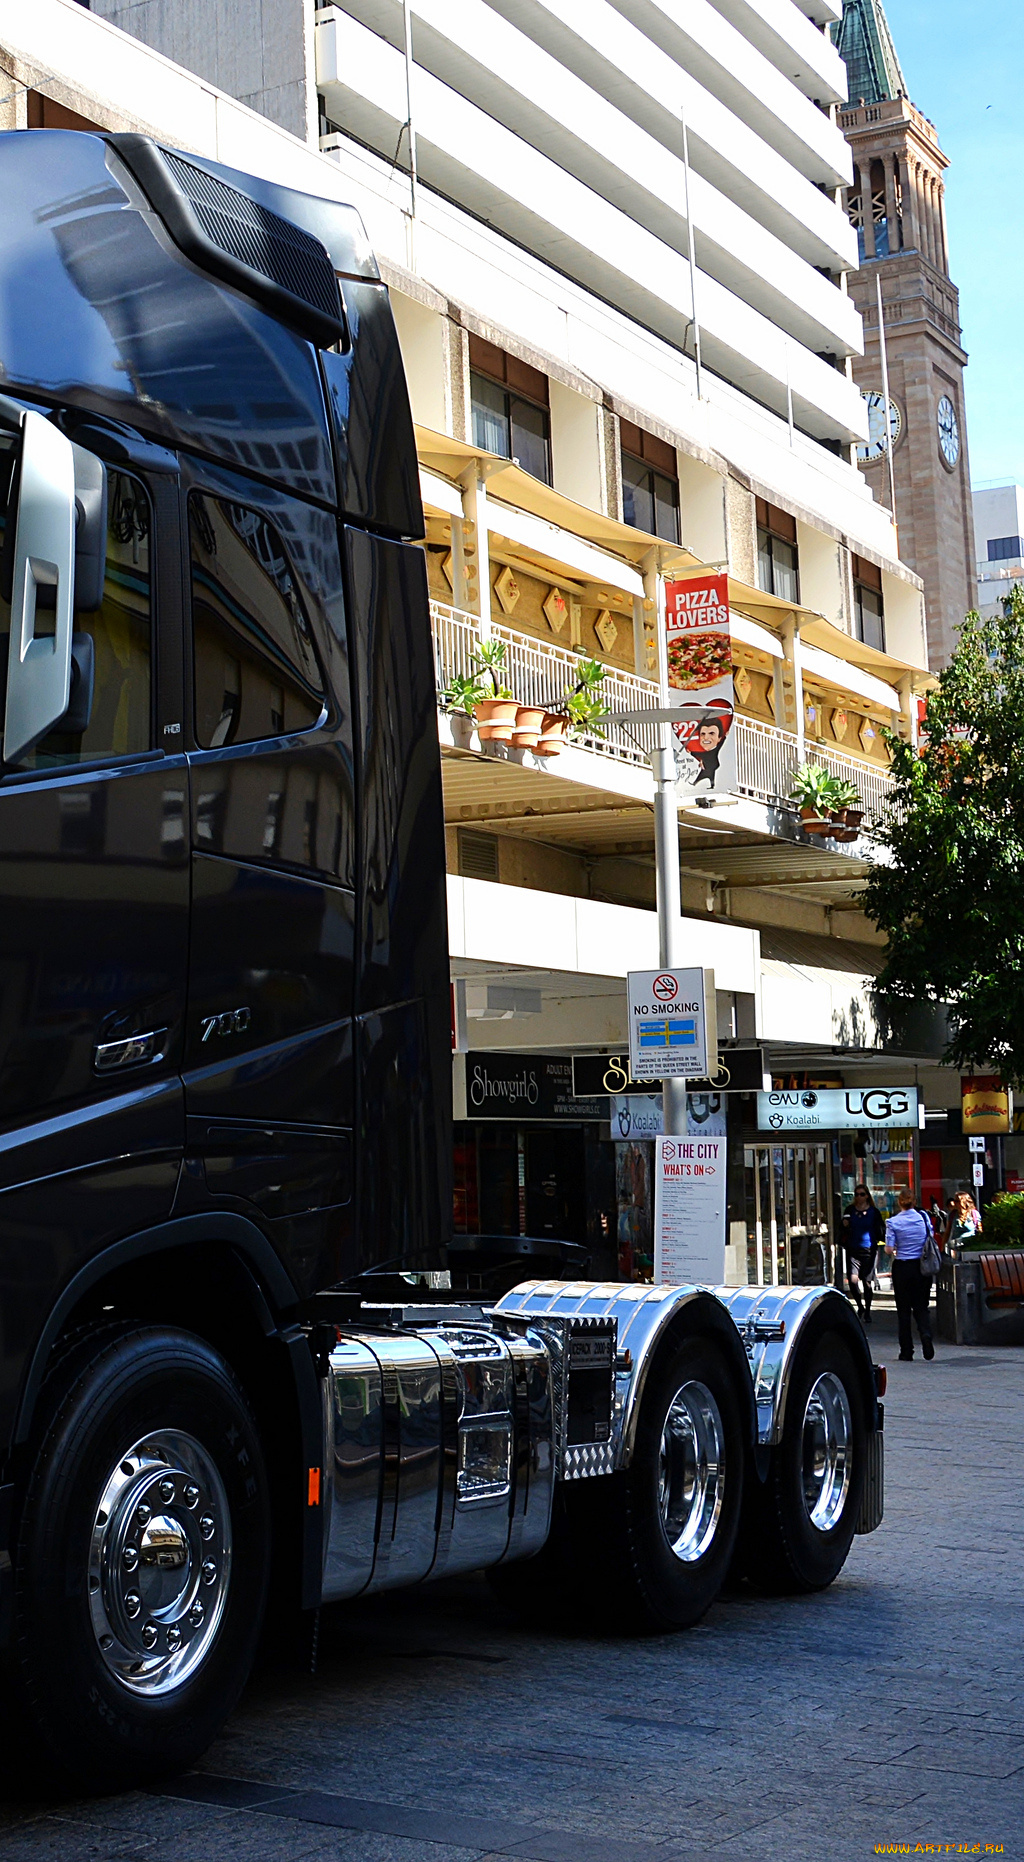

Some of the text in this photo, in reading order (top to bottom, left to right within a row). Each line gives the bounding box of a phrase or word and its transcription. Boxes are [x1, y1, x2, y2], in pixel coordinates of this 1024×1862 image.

[675, 588, 720, 611] PIZZA
[668, 605, 727, 630] LOVERS
[634, 1002, 699, 1015] NO SMOKING
[201, 1007, 251, 1042] 700
[845, 1090, 909, 1120] UGG
[787, 1114, 820, 1125] Koalabi
[677, 1143, 719, 1159] THE CITY
[663, 1163, 704, 1176] WHAT'S ON
